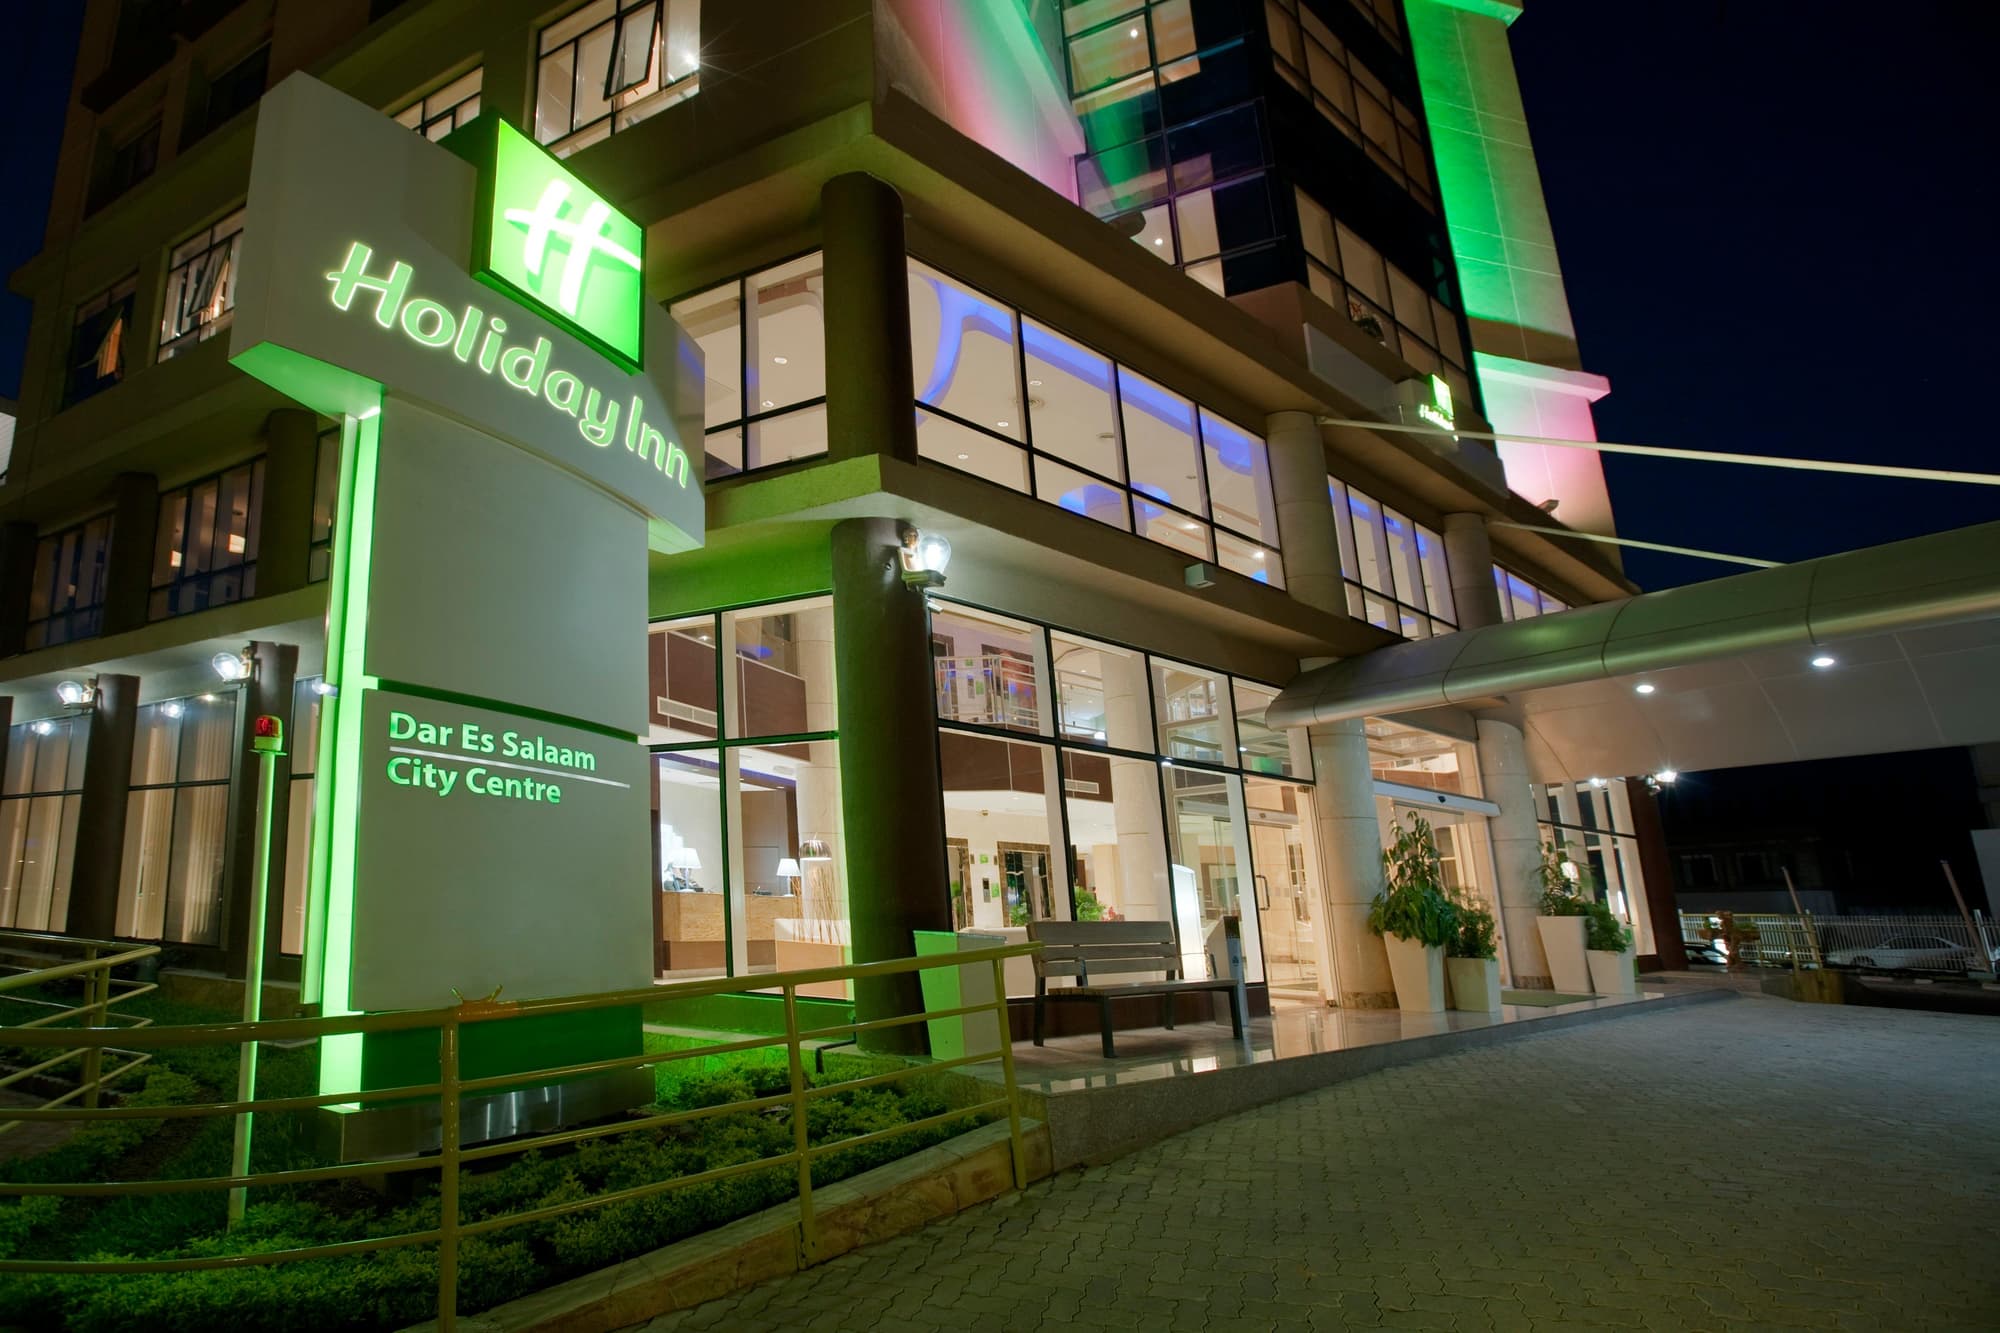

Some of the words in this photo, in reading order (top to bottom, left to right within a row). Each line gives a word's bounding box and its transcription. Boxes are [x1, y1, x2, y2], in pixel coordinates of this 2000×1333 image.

[326, 241, 620, 447] Holiday
[624, 396, 690, 489] Inn
[389, 711, 453, 746] Dar
[462, 723, 495, 753] Es
[502, 731, 596, 771] Salaam
[386, 756, 458, 797] City
[465, 767, 561, 804] Centre
